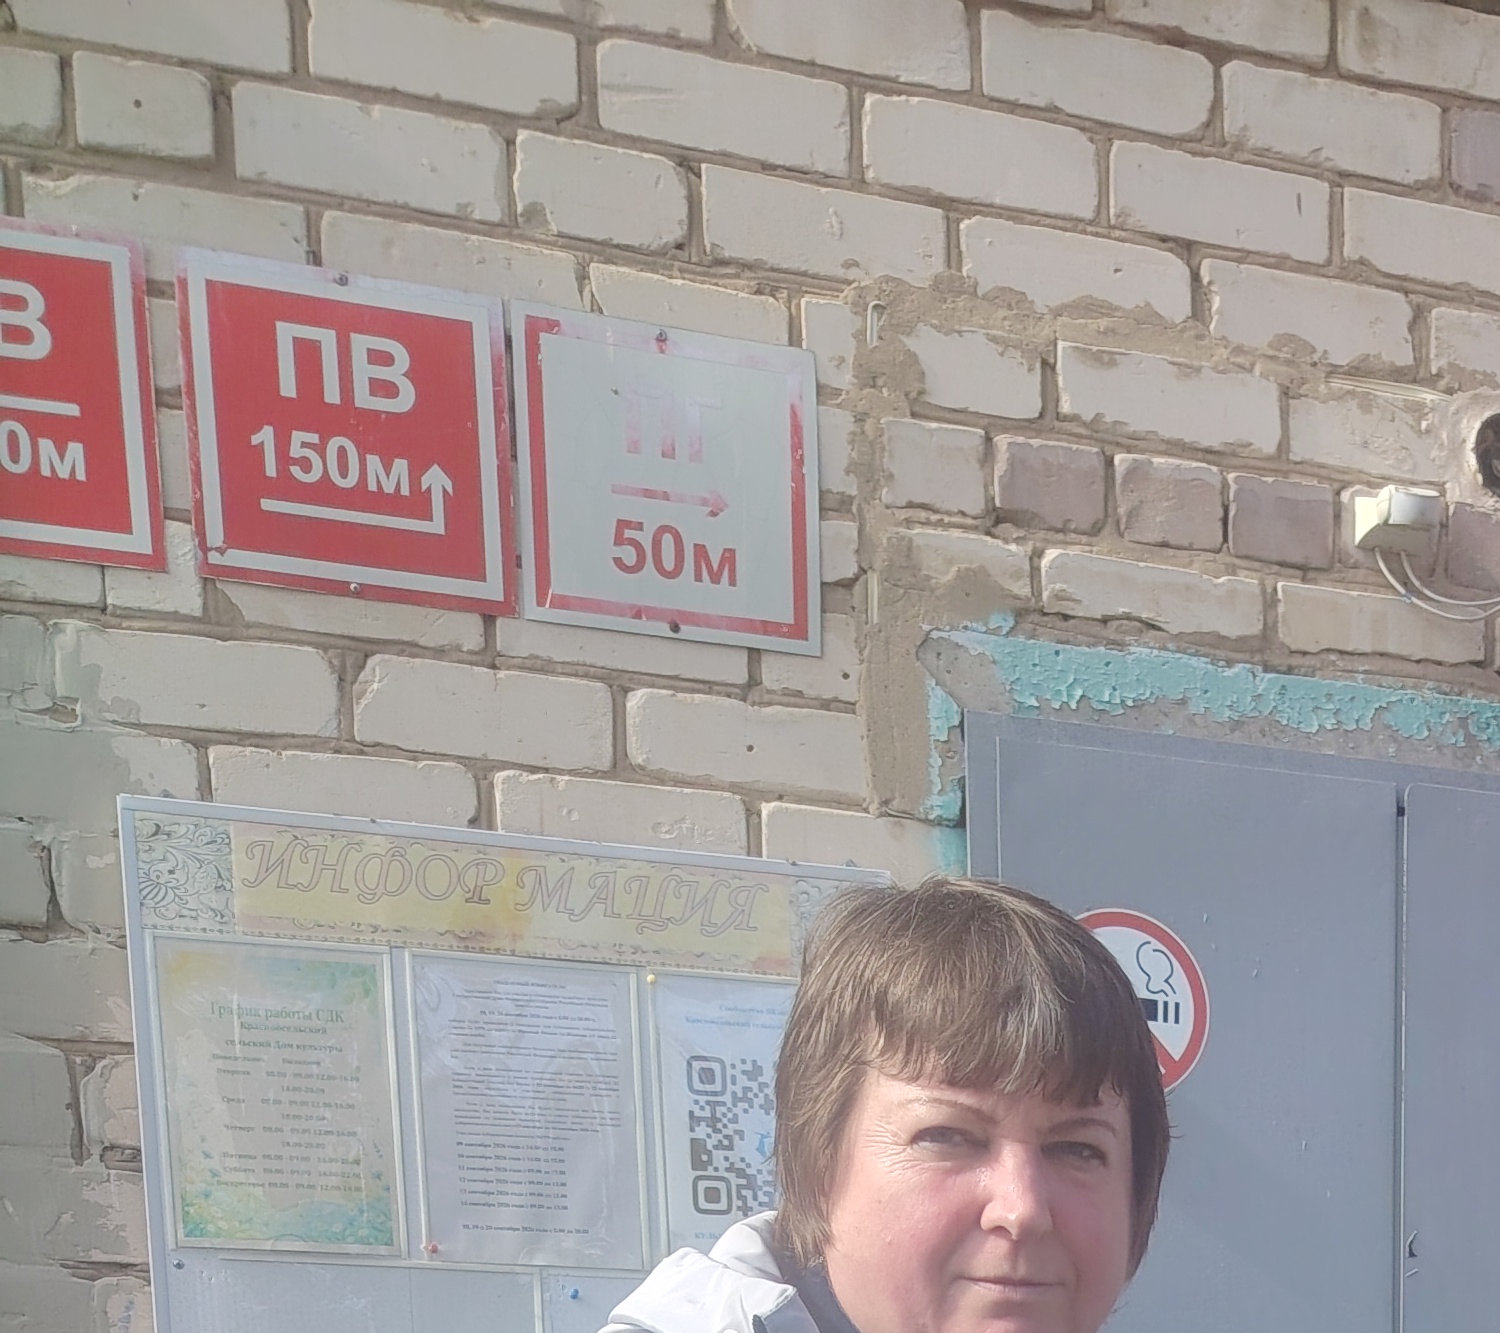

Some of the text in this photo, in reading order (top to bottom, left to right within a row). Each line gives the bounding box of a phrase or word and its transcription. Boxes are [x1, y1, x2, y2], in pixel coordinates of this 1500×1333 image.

[275, 321, 417, 414] ПВ
[250, 424, 411, 497] 150м
[611, 519, 739, 589] 50м
